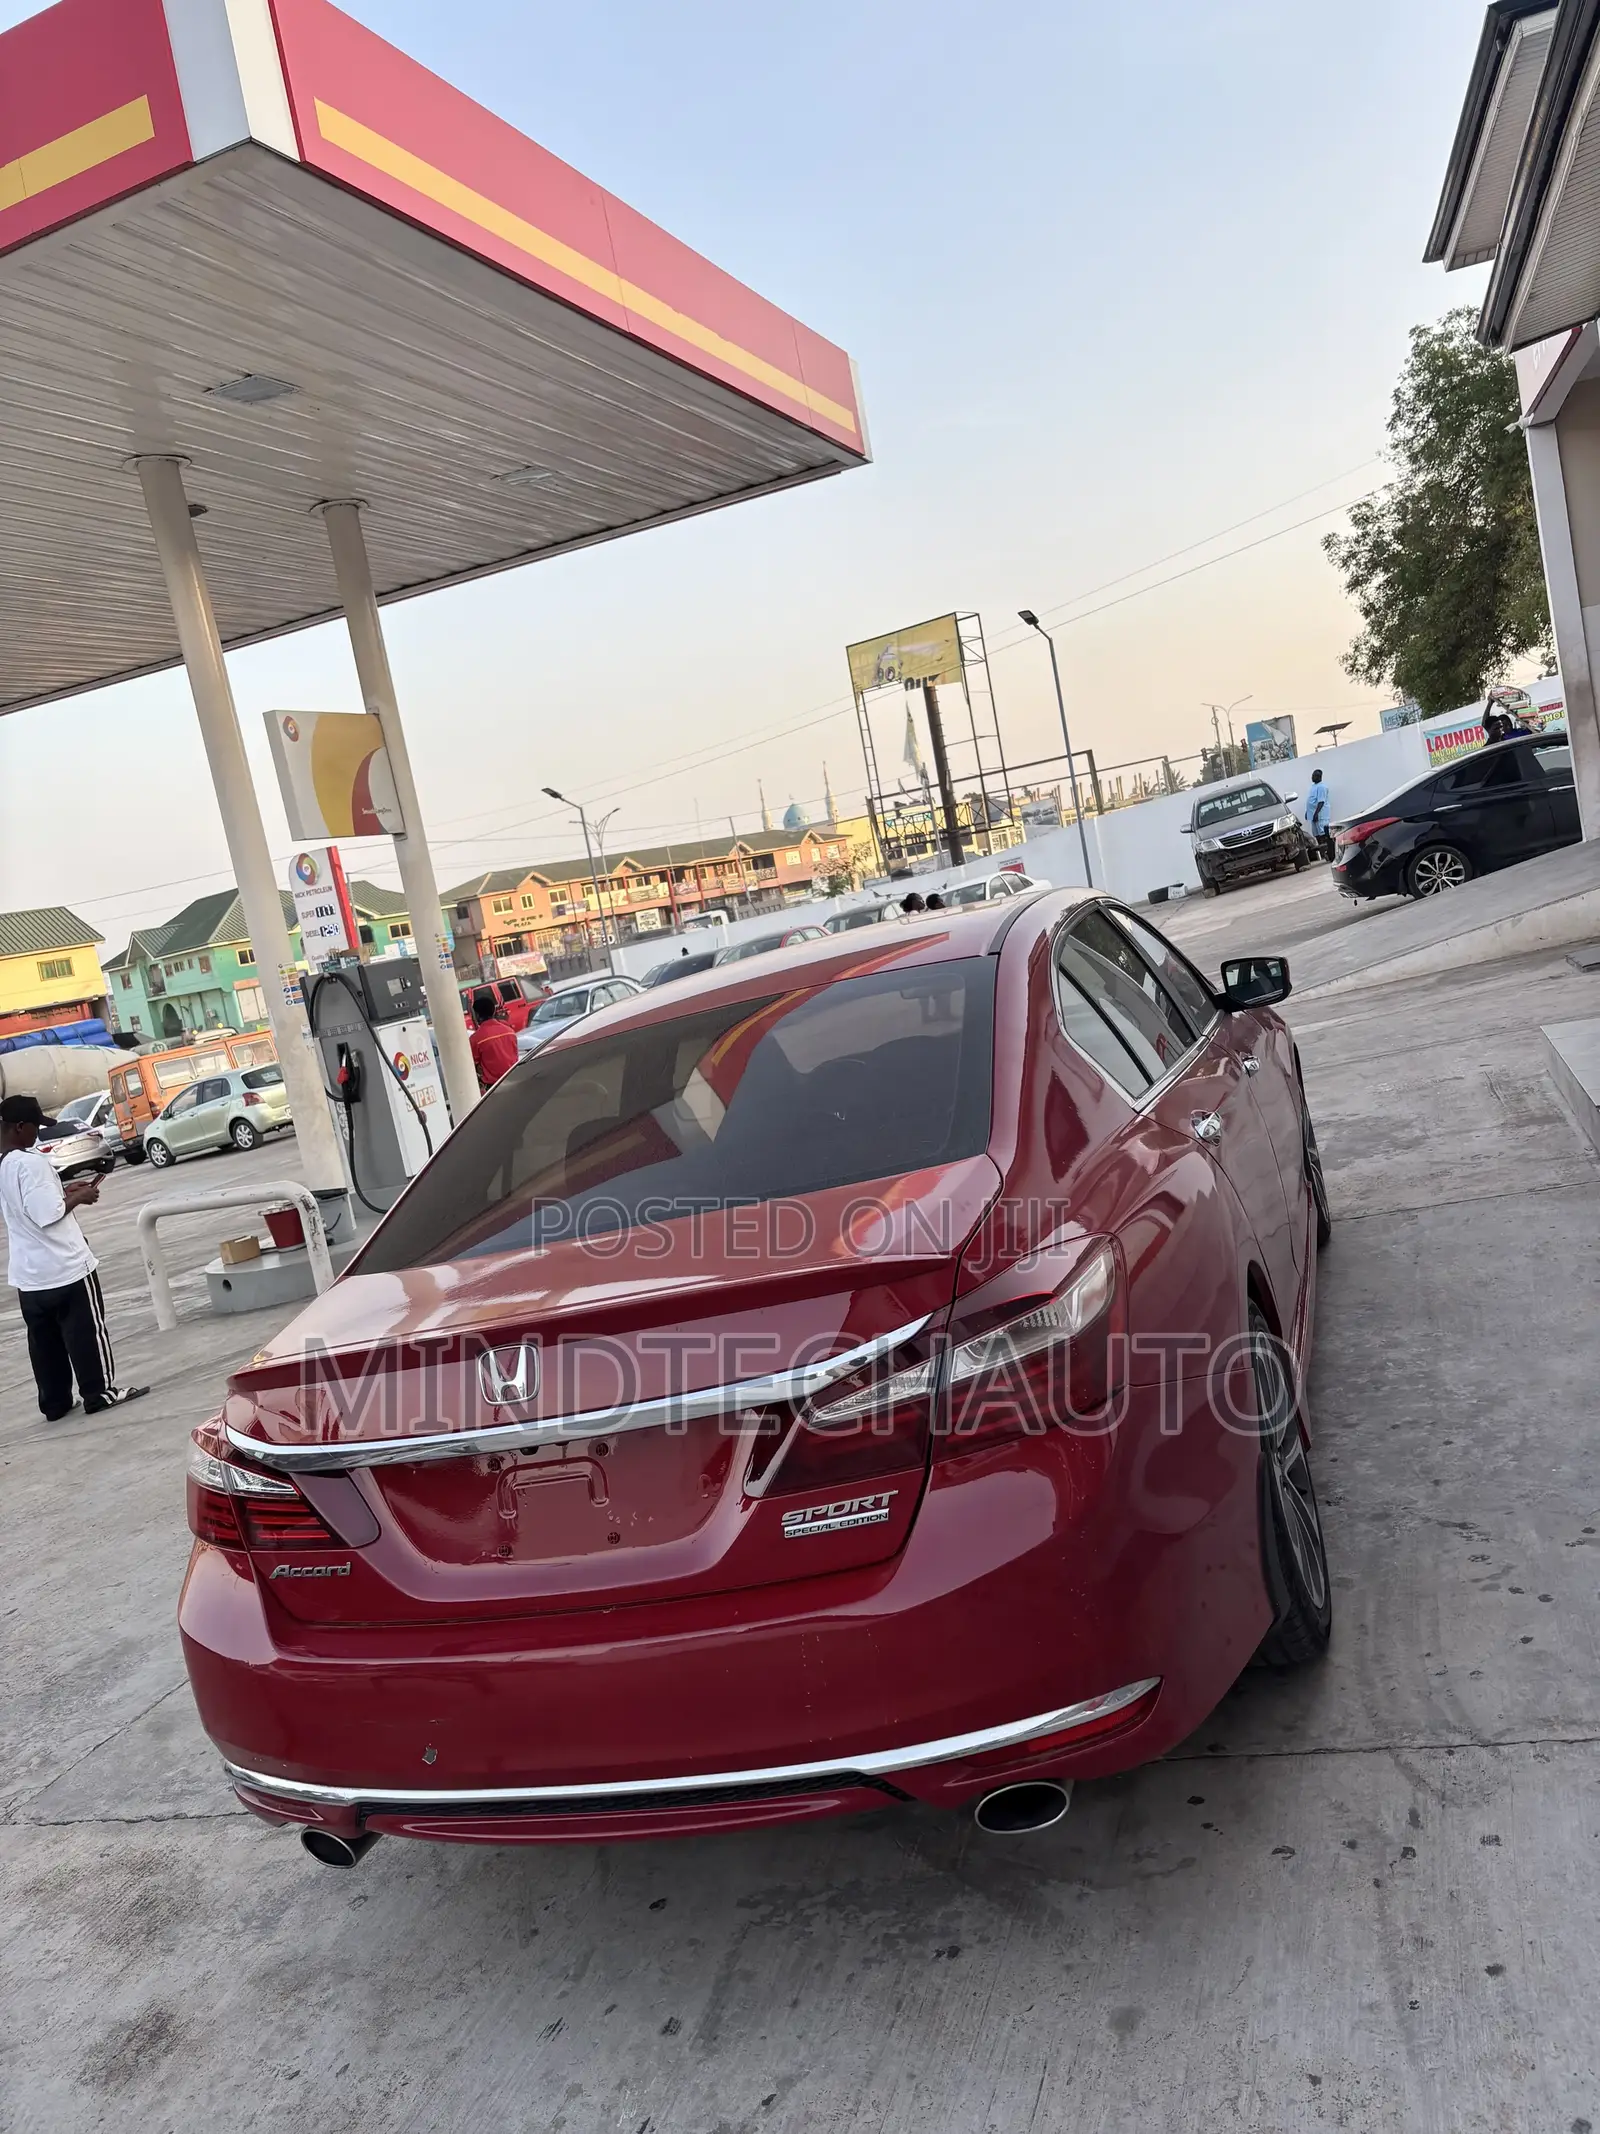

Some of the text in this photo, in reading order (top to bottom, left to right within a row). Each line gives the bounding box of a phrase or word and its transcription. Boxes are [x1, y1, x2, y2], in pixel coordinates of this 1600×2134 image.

[1426, 725, 1486, 753] LAUNDR
[306, 886, 333, 897] PETROLEUM
[301, 909, 316, 920] SUPER
[305, 929, 321, 939] DIESEL
[410, 1050, 429, 1066] NICK
[781, 1490, 899, 1526] SPORT
[785, 1512, 888, 1537] SPECIAL EDITION
[269, 1561, 351, 1579] Accord
